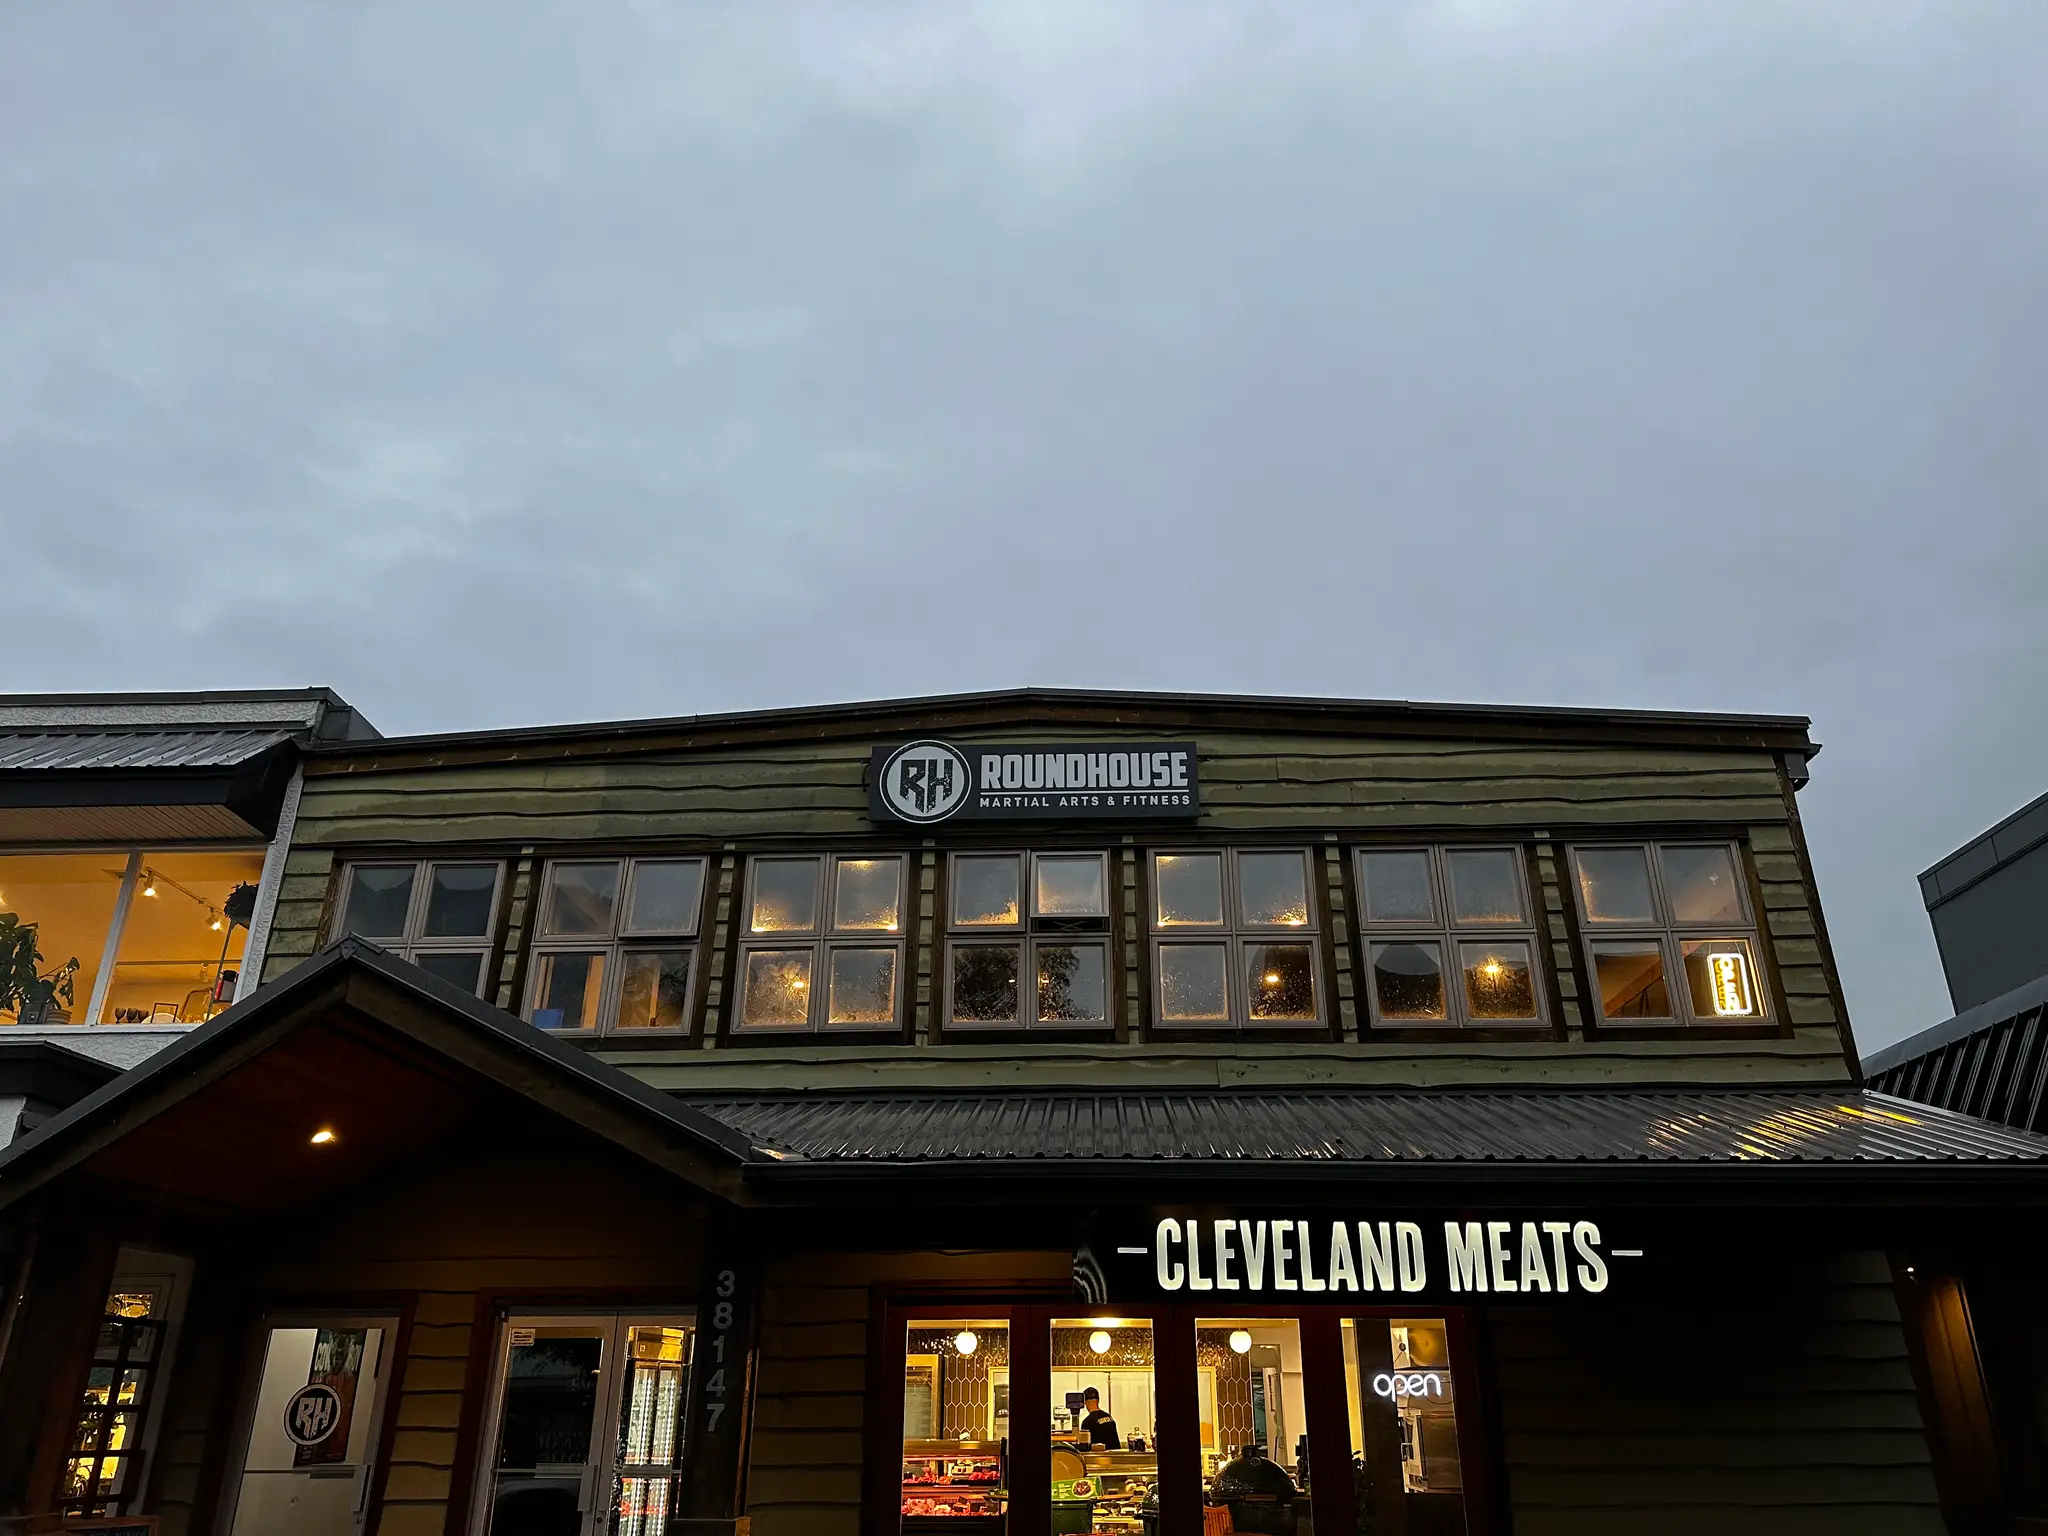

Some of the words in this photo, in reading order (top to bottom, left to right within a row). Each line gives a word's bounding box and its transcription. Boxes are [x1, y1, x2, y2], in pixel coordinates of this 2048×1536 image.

[900, 758, 954, 815] RH
[979, 751, 1189, 790] ROUNDHOUSE
[979, 796, 1050, 808] MARTIAL
[1059, 795, 1099, 807] ARTS
[1107, 795, 1115, 806] &
[1123, 794, 1191, 806] FITNESS
[1156, 1217, 1427, 1292] CLEVELAND
[1444, 1219, 1609, 1293] MEATS
[705, 1270, 736, 1432] 38147
[1373, 1373, 1442, 1403] open
[295, 1397, 334, 1439] RH
